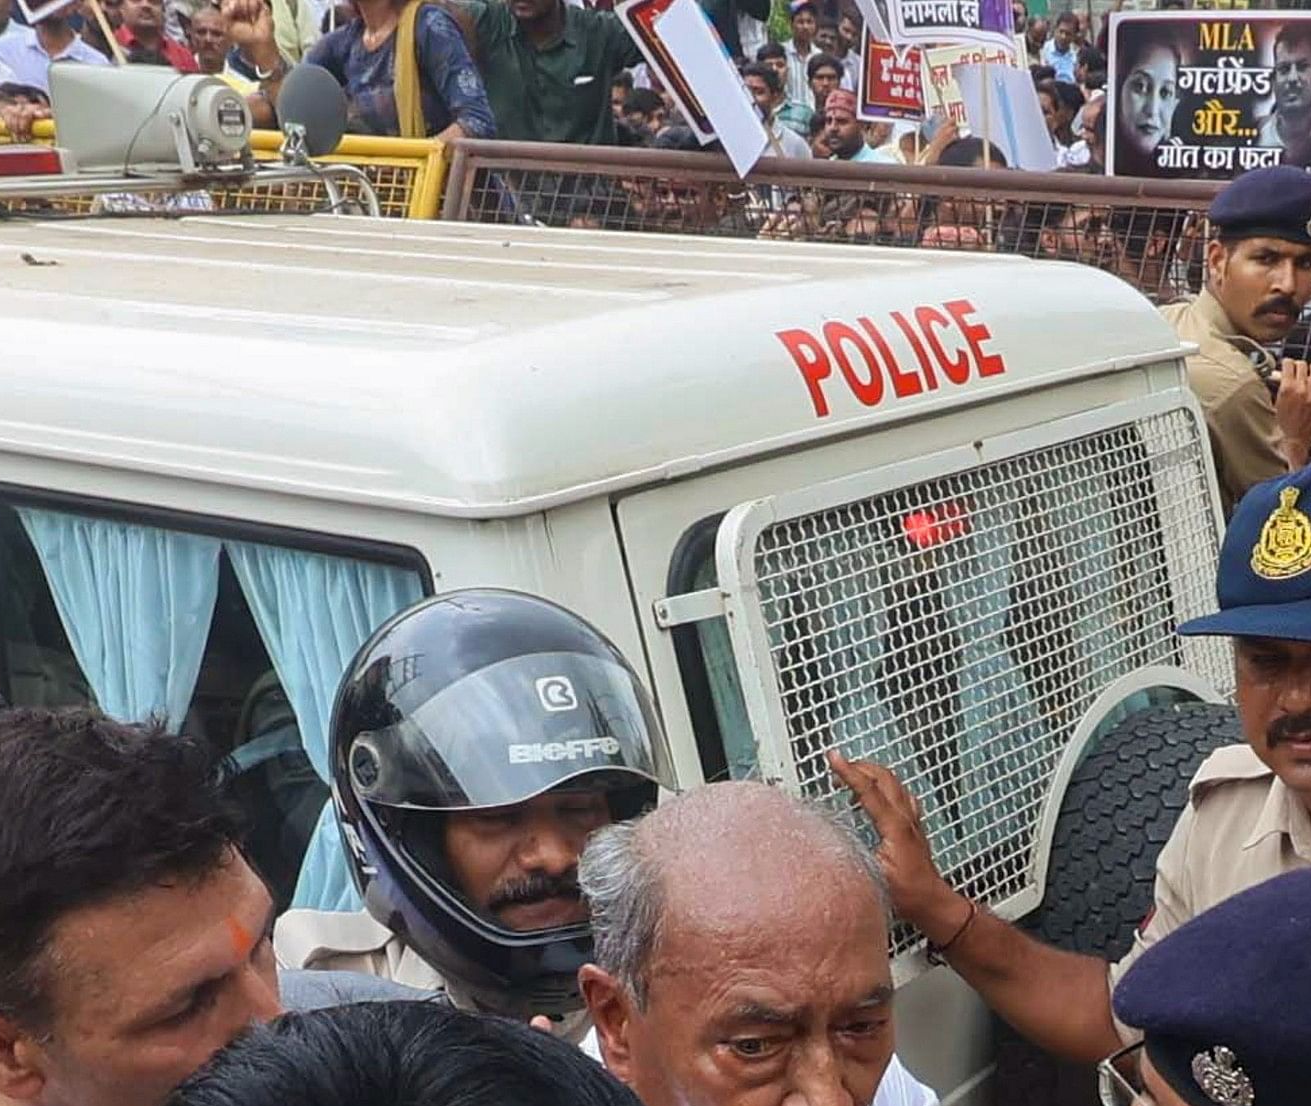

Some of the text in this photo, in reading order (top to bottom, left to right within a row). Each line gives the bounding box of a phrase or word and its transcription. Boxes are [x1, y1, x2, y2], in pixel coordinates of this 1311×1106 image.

[901, 1, 958, 23] मामला
[1198, 22, 1255, 50] MLA
[1178, 57, 1274, 95] गर्लफ्रेंड
[1192, 99, 1258, 137] और...
[1157, 136, 1283, 169] मौत का फंदा
[775, 299, 1006, 418] POLICE
